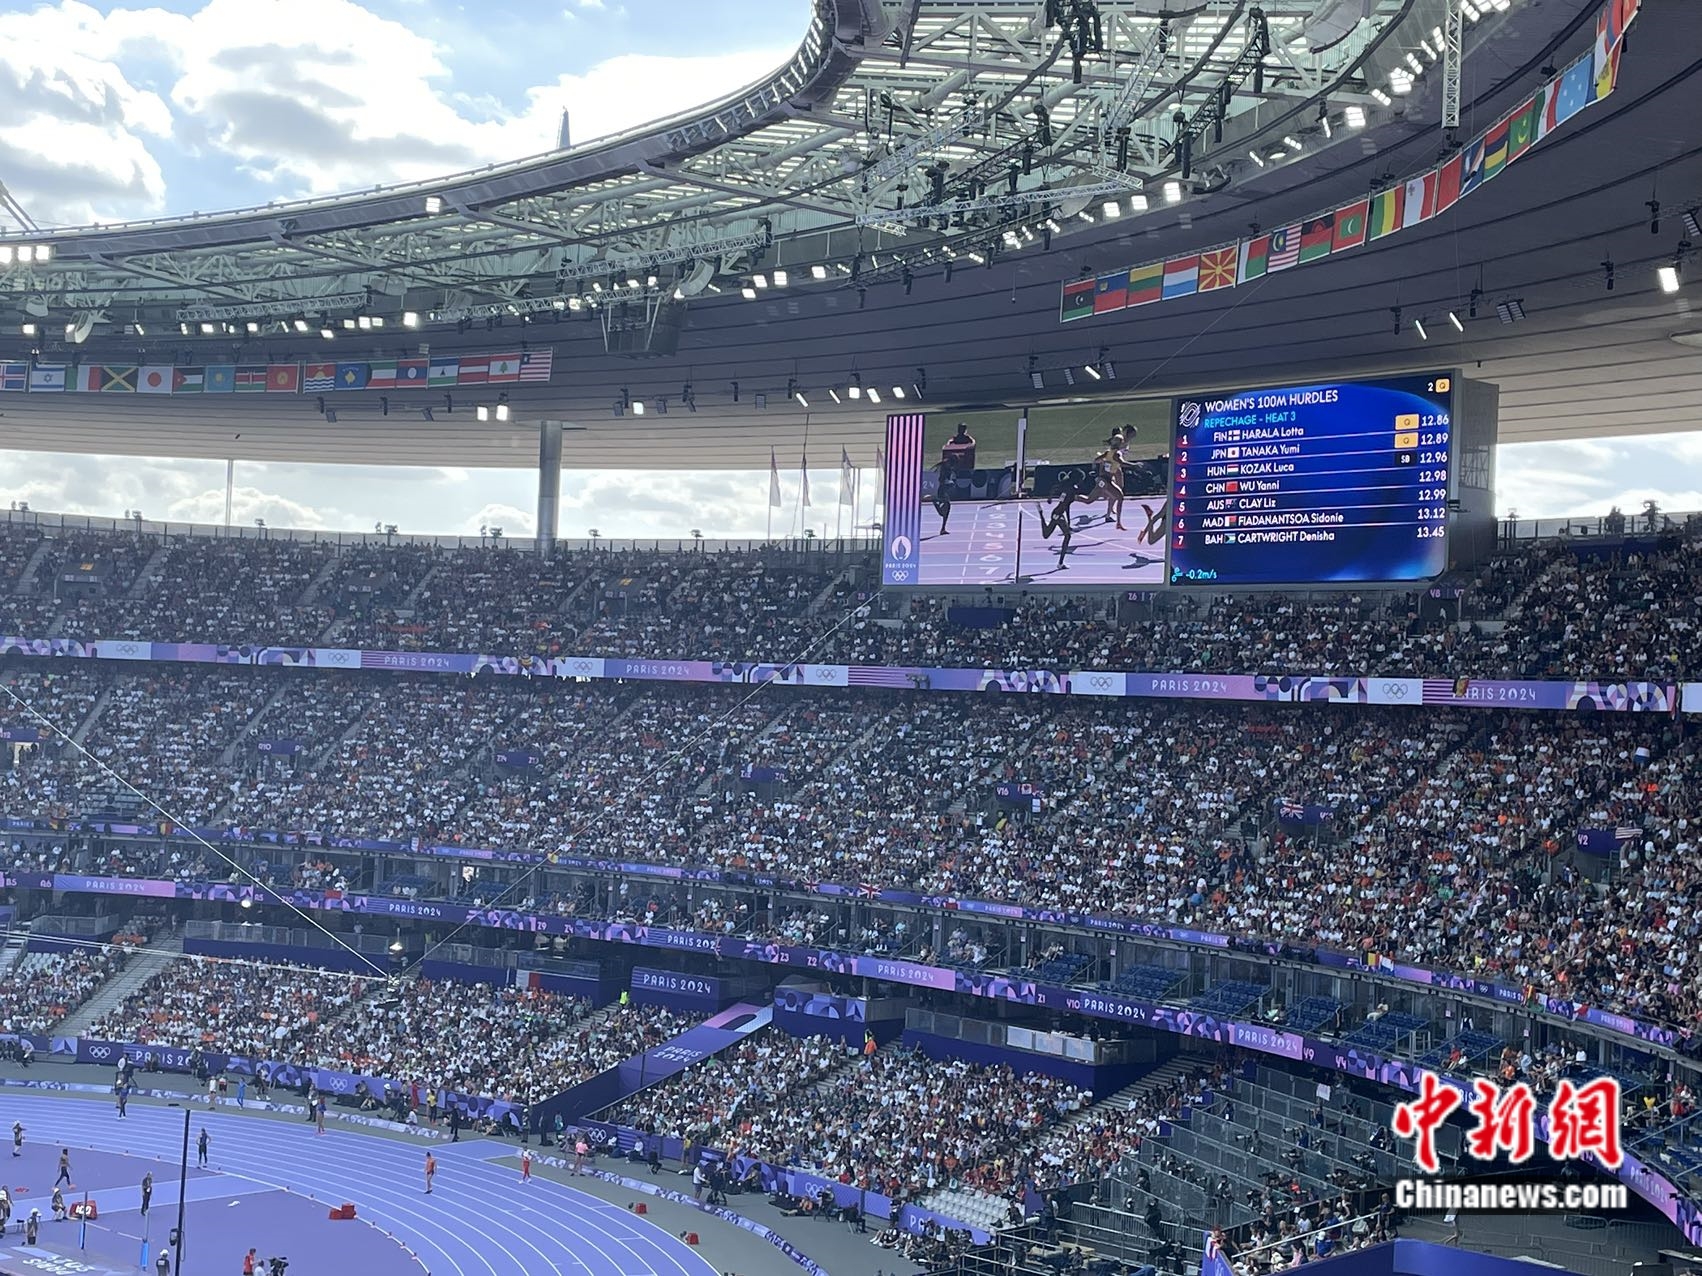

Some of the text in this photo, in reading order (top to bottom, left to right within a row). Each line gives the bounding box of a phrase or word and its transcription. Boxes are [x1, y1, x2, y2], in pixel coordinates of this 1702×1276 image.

[1428, 382, 1434, 392] 2
[1205, 390, 1338, 413] WOMEN'S 100M HURDLES
[1204, 414, 1256, 428] REPECHAGE
[1265, 412, 1289, 423] HEAT
[1290, 411, 1296, 422] 3
[1182, 435, 1188, 445] 1
[1214, 430, 1228, 442] FIN
[1242, 428, 1280, 440] HARALA
[1281, 427, 1304, 437] Lotta
[1421, 414, 1449, 426] 12.86
[1181, 452, 1188, 462] 2
[1211, 448, 1226, 460] JPN
[1241, 446, 1278, 457] TANAKA
[1280, 444, 1300, 455] Yumi
[1420, 433, 1448, 446] 12.89
[1180, 452, 1448, 478] 3 HUN KOZAK Luca SB 12.96
[1179, 470, 1446, 496] 4 CHN WU Yanni 12.98
[1179, 489, 1446, 512] 5 AUS CLAY Liz 12.99
[1178, 508, 1446, 528] 6 MAD FIADANANTSOA Sidonie 13.12
[1178, 526, 1445, 545] 7 BAH CARTWRIGHT Denisha 13.45
[1186, 569, 1217, 580] -0.2m/s
[384, 656, 449, 667] PARIS 2024
[626, 664, 689, 675] PARIS 2024
[1152, 680, 1227, 692] PARIS 2024
[1455, 687, 1536, 700] RIS 2024
[86, 880, 144, 891] PARIS 2024
[389, 904, 441, 916] PARIS 2024
[667, 935, 718, 950] PARIS 202
[878, 964, 934, 982] PARIS 2024
[643, 974, 711, 994] PARIS 2024
[1084, 998, 1145, 1019] PARIS 2024
[1239, 1029, 1298, 1053] PARIS 2024
[136, 1050, 173, 1064] PAIS
[663, 1046, 702, 1057] PARIS
